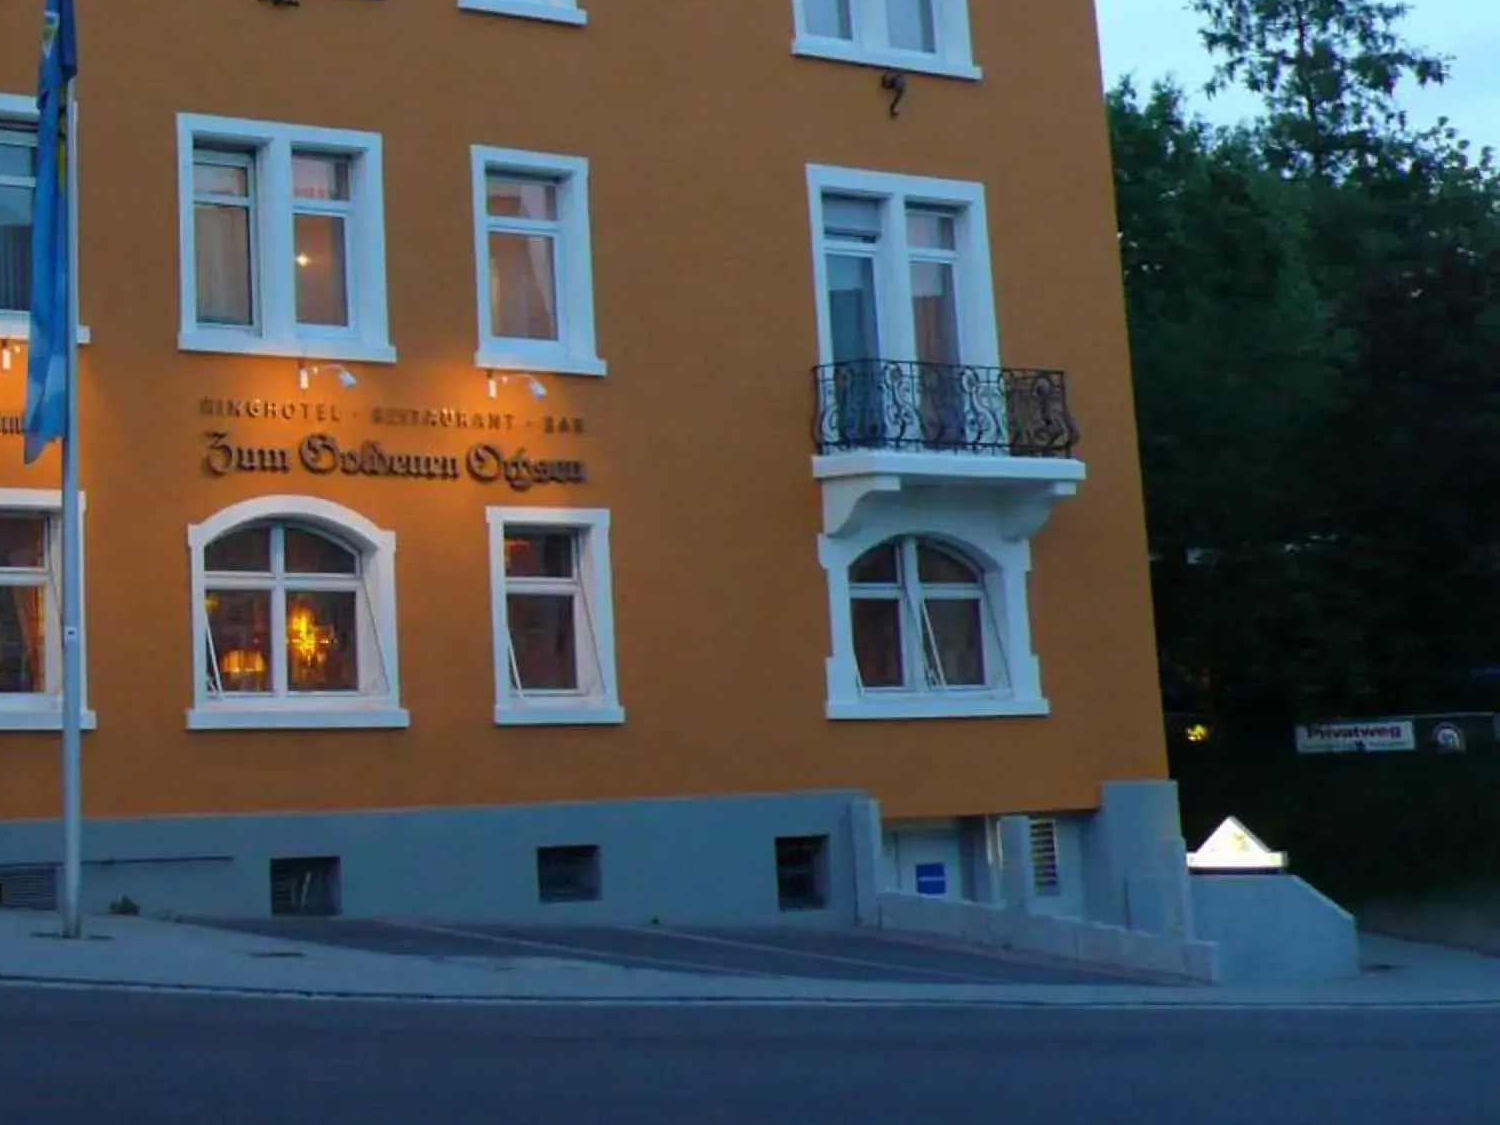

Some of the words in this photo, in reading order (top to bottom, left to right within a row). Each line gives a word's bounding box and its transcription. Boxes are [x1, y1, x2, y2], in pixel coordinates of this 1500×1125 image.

[544, 415, 584, 435] BAR
[202, 431, 291, 479] Zum
[299, 432, 459, 479] Goldenen
